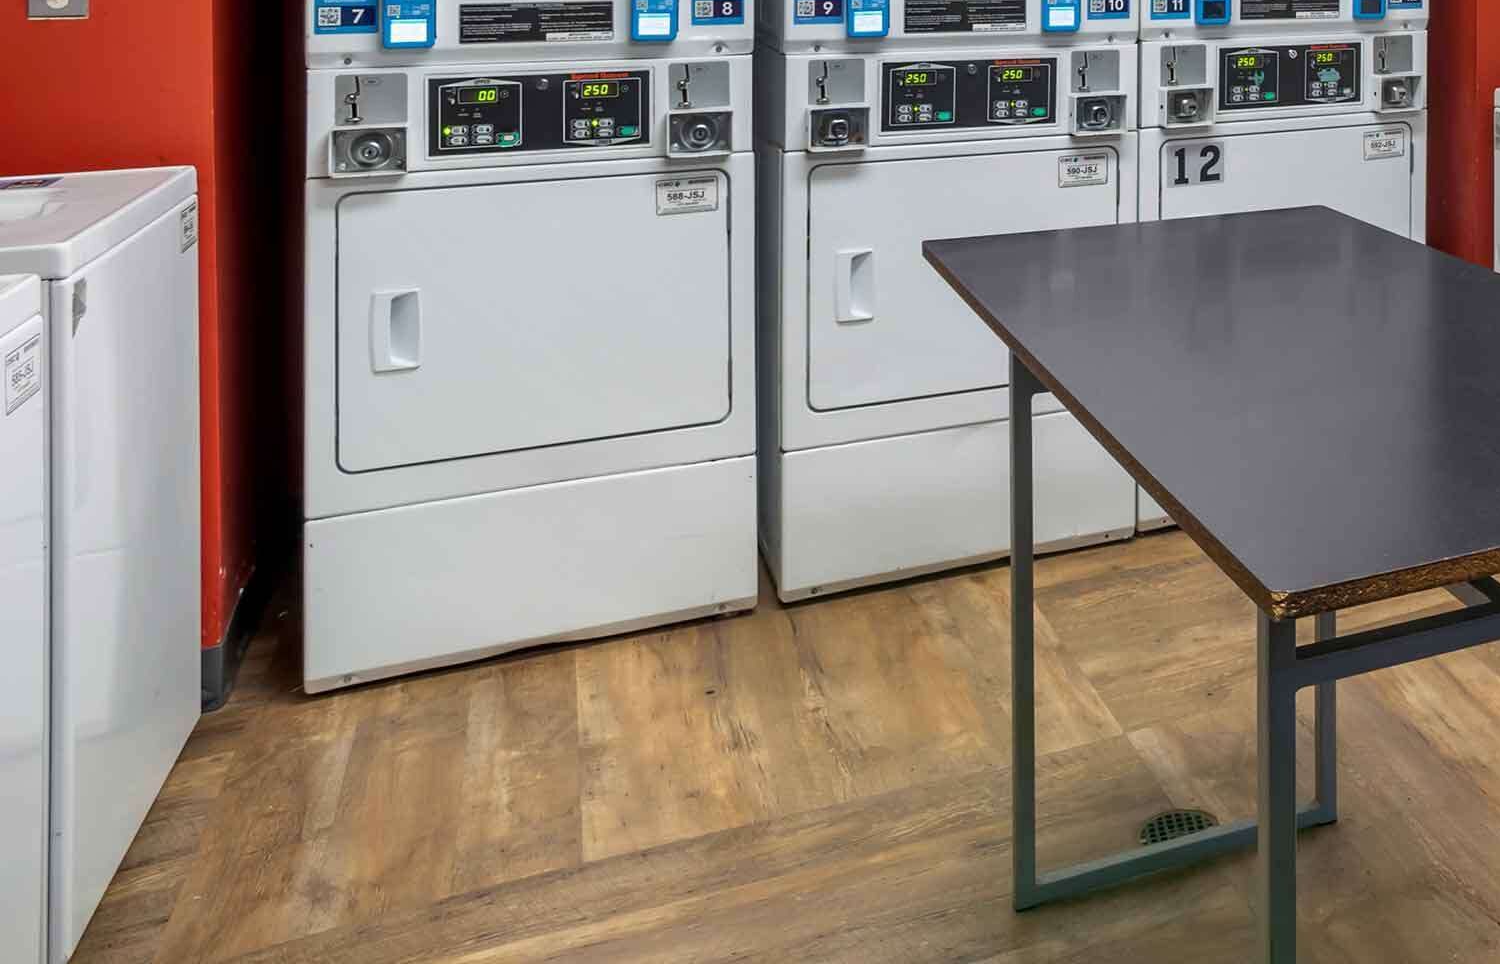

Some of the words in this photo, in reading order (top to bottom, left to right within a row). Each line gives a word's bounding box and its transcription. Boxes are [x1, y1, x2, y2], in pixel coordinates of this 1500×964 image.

[721, 1, 733, 16] 8
[823, 1, 833, 15] 9
[351, 8, 365, 24] 7
[1237, 56, 1256, 67] 250
[1316, 52, 1333, 63] 250
[905, 73, 928, 84] 250
[1002, 69, 1024, 80] 250
[583, 84, 609, 96] 250
[1066, 165, 1097, 176] 590-JSJ
[1174, 145, 1221, 185] 12
[666, 190, 705, 202] 588-JSJ
